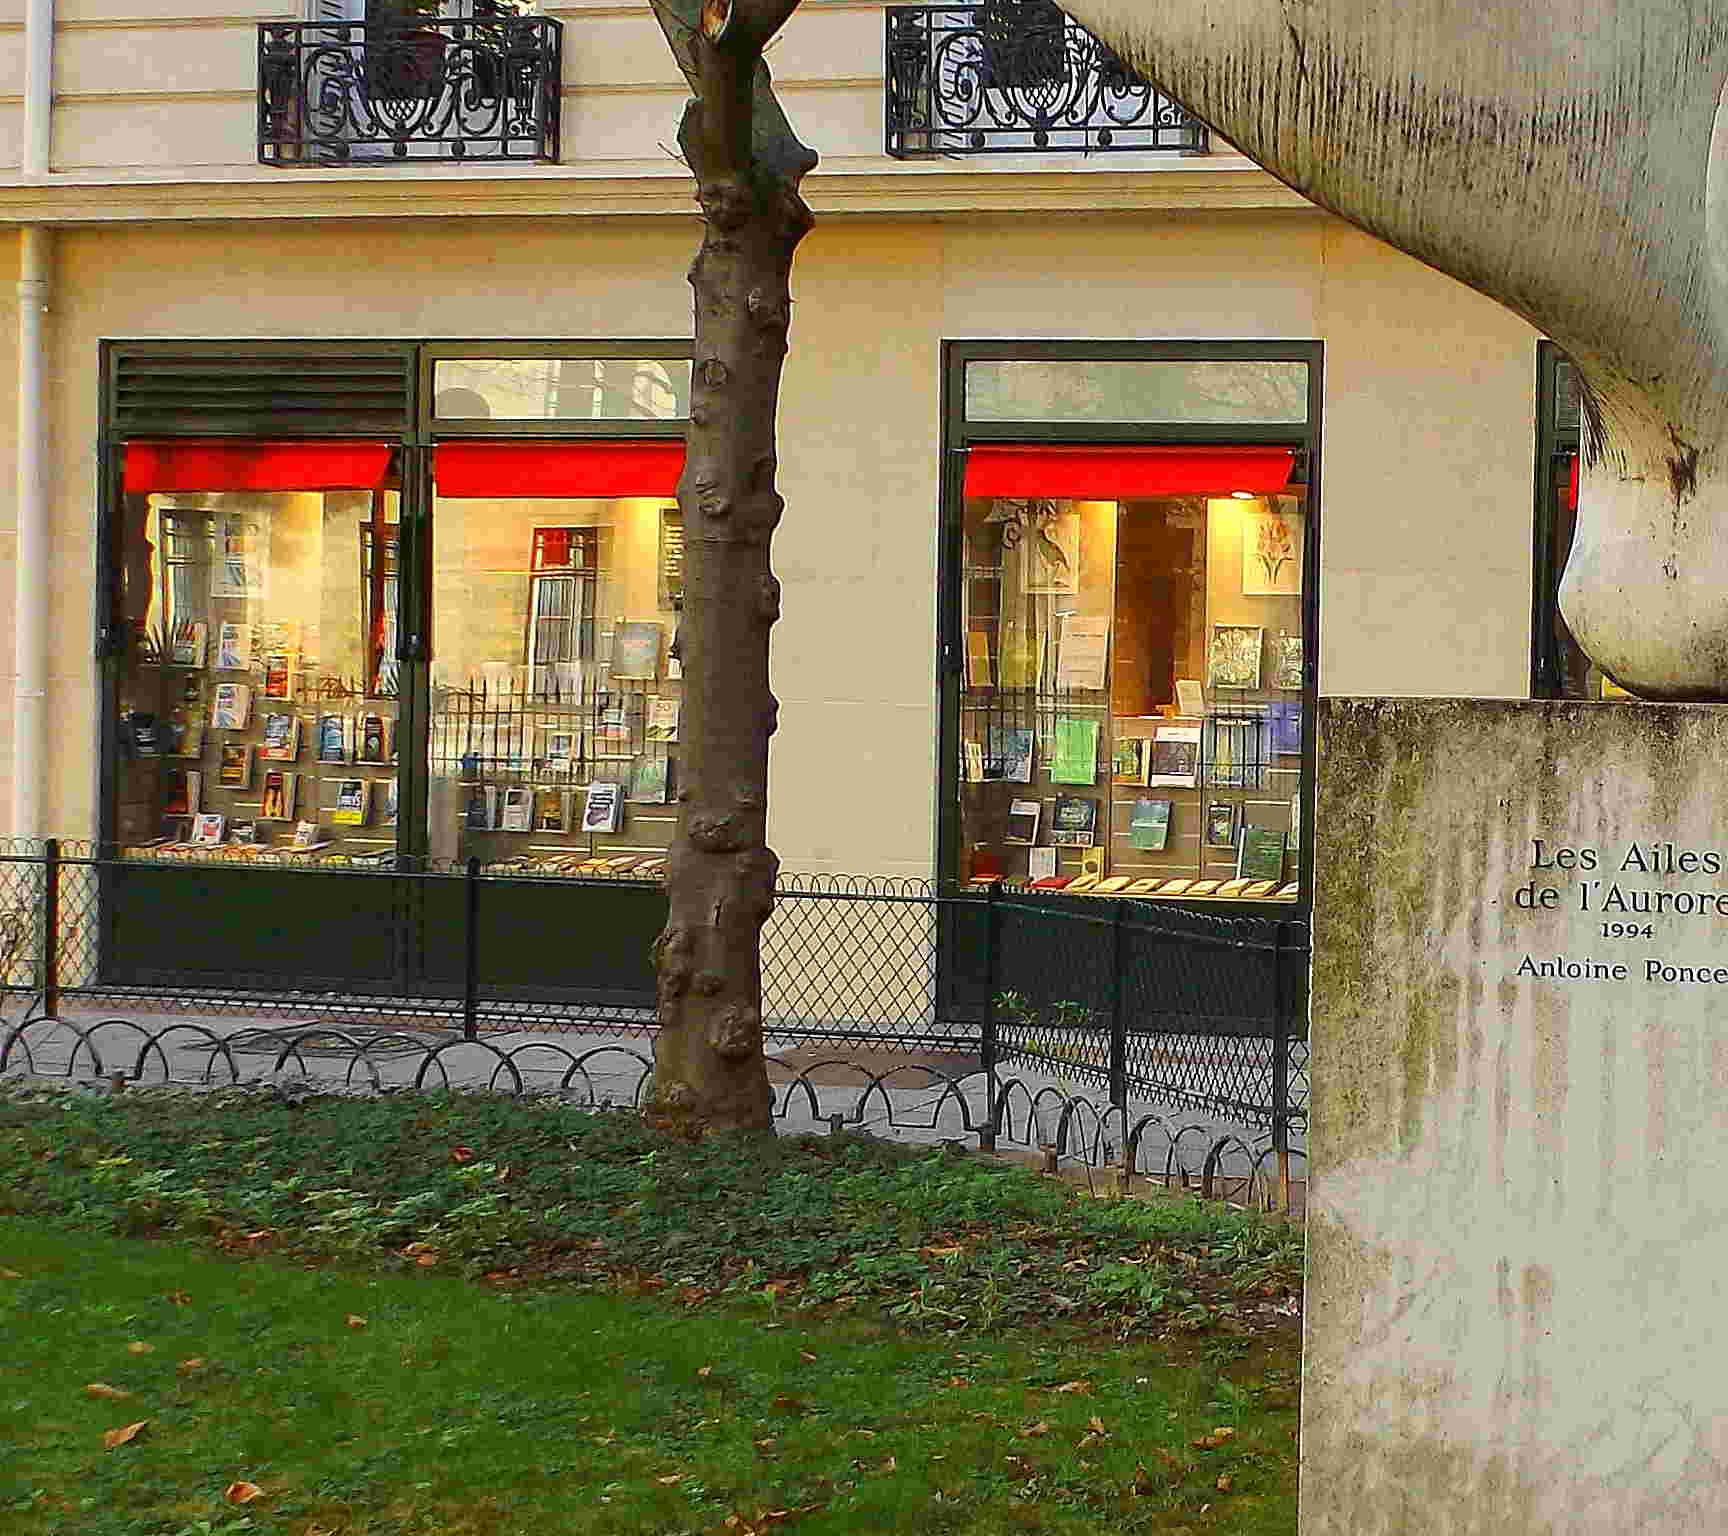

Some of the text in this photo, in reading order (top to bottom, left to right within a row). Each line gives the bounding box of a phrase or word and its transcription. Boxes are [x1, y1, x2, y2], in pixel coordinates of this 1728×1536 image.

[1531, 839, 1721, 874] Les Ailes
[1514, 880, 1560, 910] de
[1601, 922, 1655, 939] 1994
[1516, 954, 1628, 981] Antoine
